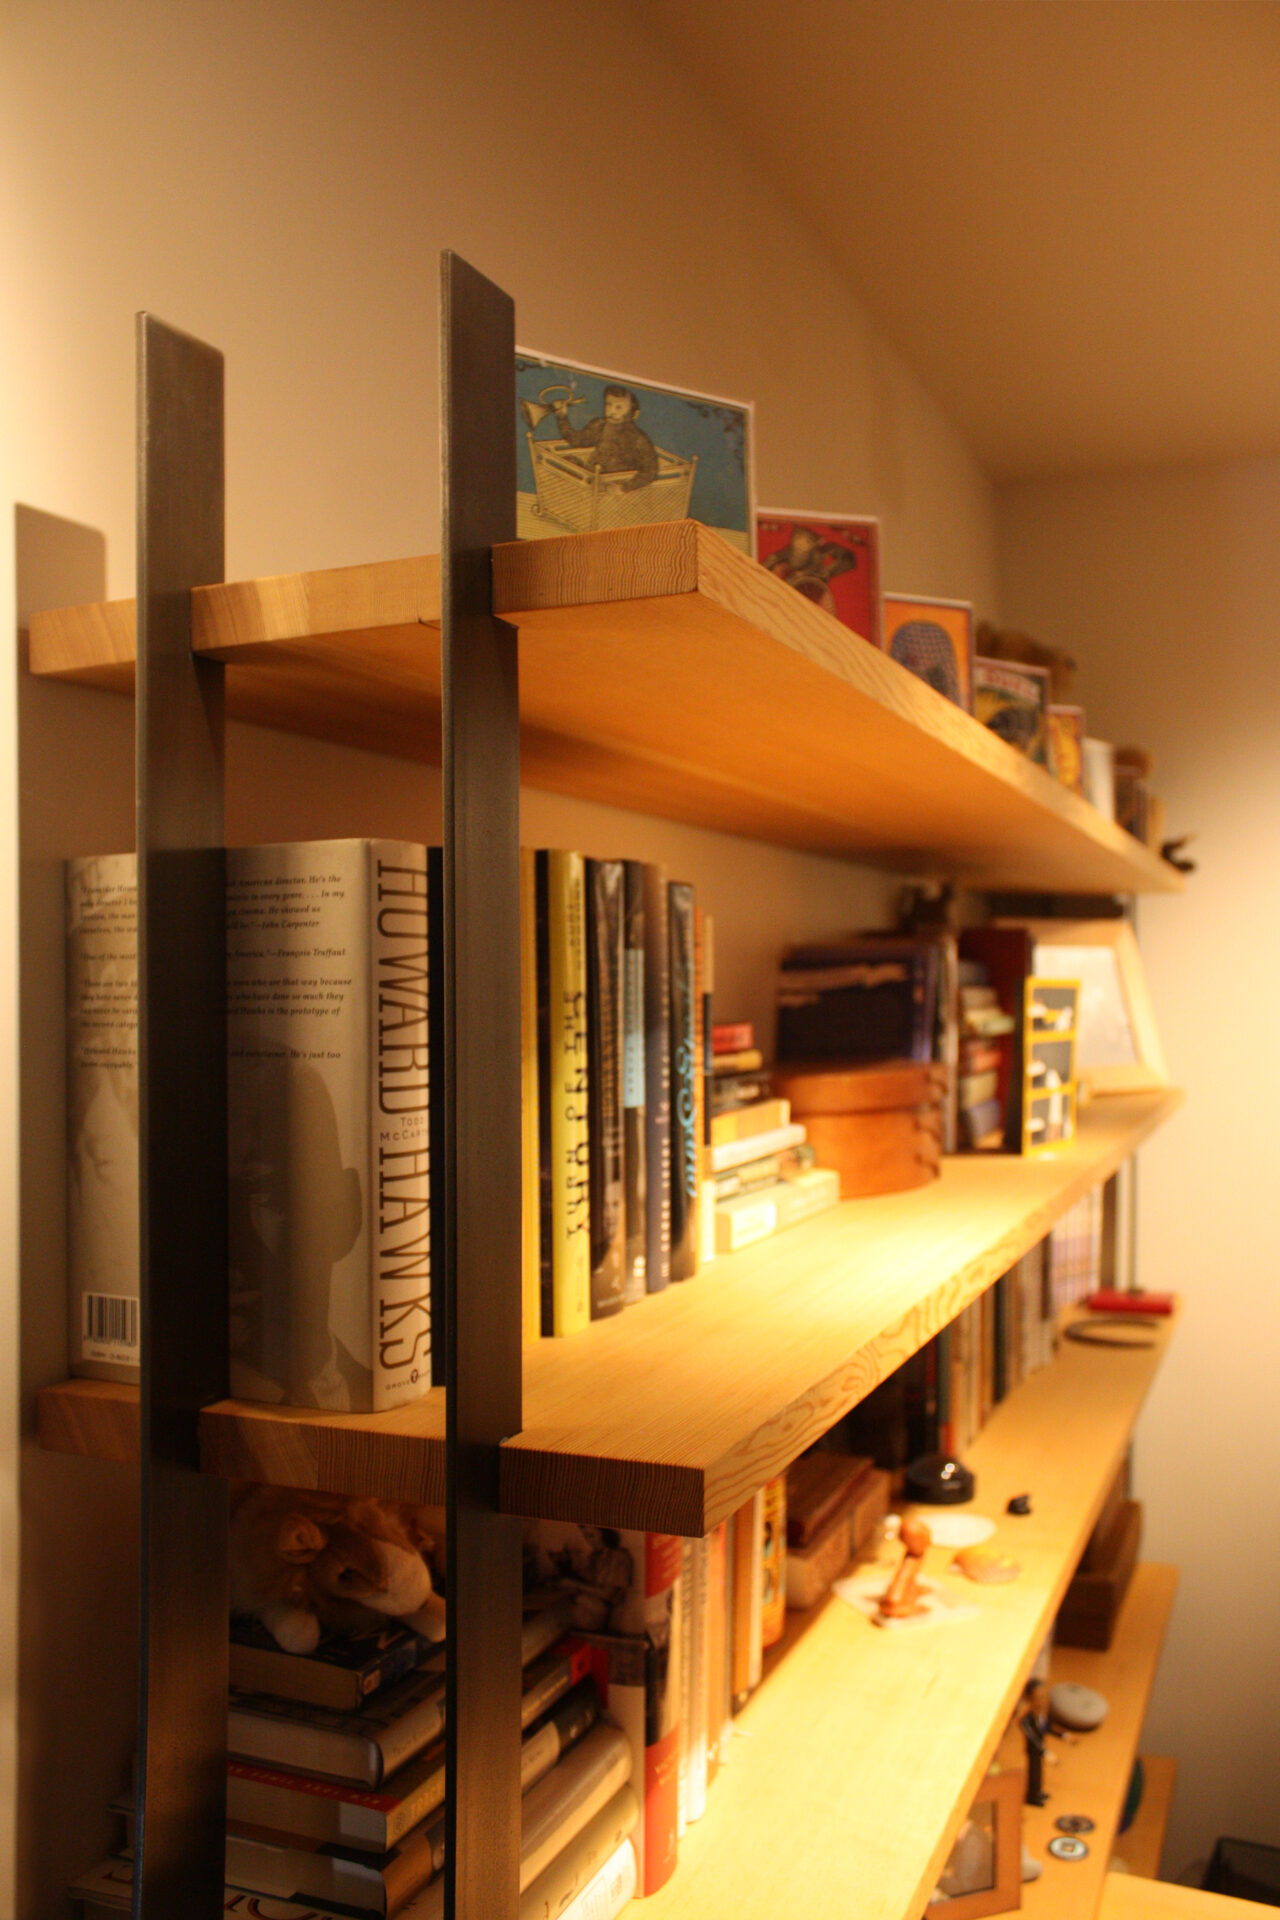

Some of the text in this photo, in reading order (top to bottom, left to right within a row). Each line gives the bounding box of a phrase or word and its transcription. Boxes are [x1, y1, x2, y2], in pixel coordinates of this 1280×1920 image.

[308, 875, 326, 884] He's
[328, 874, 342, 884] the
[321, 889, 330, 898] In
[331, 890, 345, 901] my
[281, 919, 320, 931] Carpenter
[313, 947, 346, 960] Truffaut
[300, 978, 318, 988] way
[319, 976, 352, 986] because
[302, 991, 324, 1000] much
[325, 991, 344, 1002] they
[276, 1006, 289, 1015] the
[290, 1005, 329, 1017] prototype
[330, 1005, 342, 1017] of
[289, 1049, 307, 1058] He's
[307, 1050, 326, 1061] just
[326, 1051, 342, 1059] too
[378, 860, 432, 1370] HOWARD HAWKS
